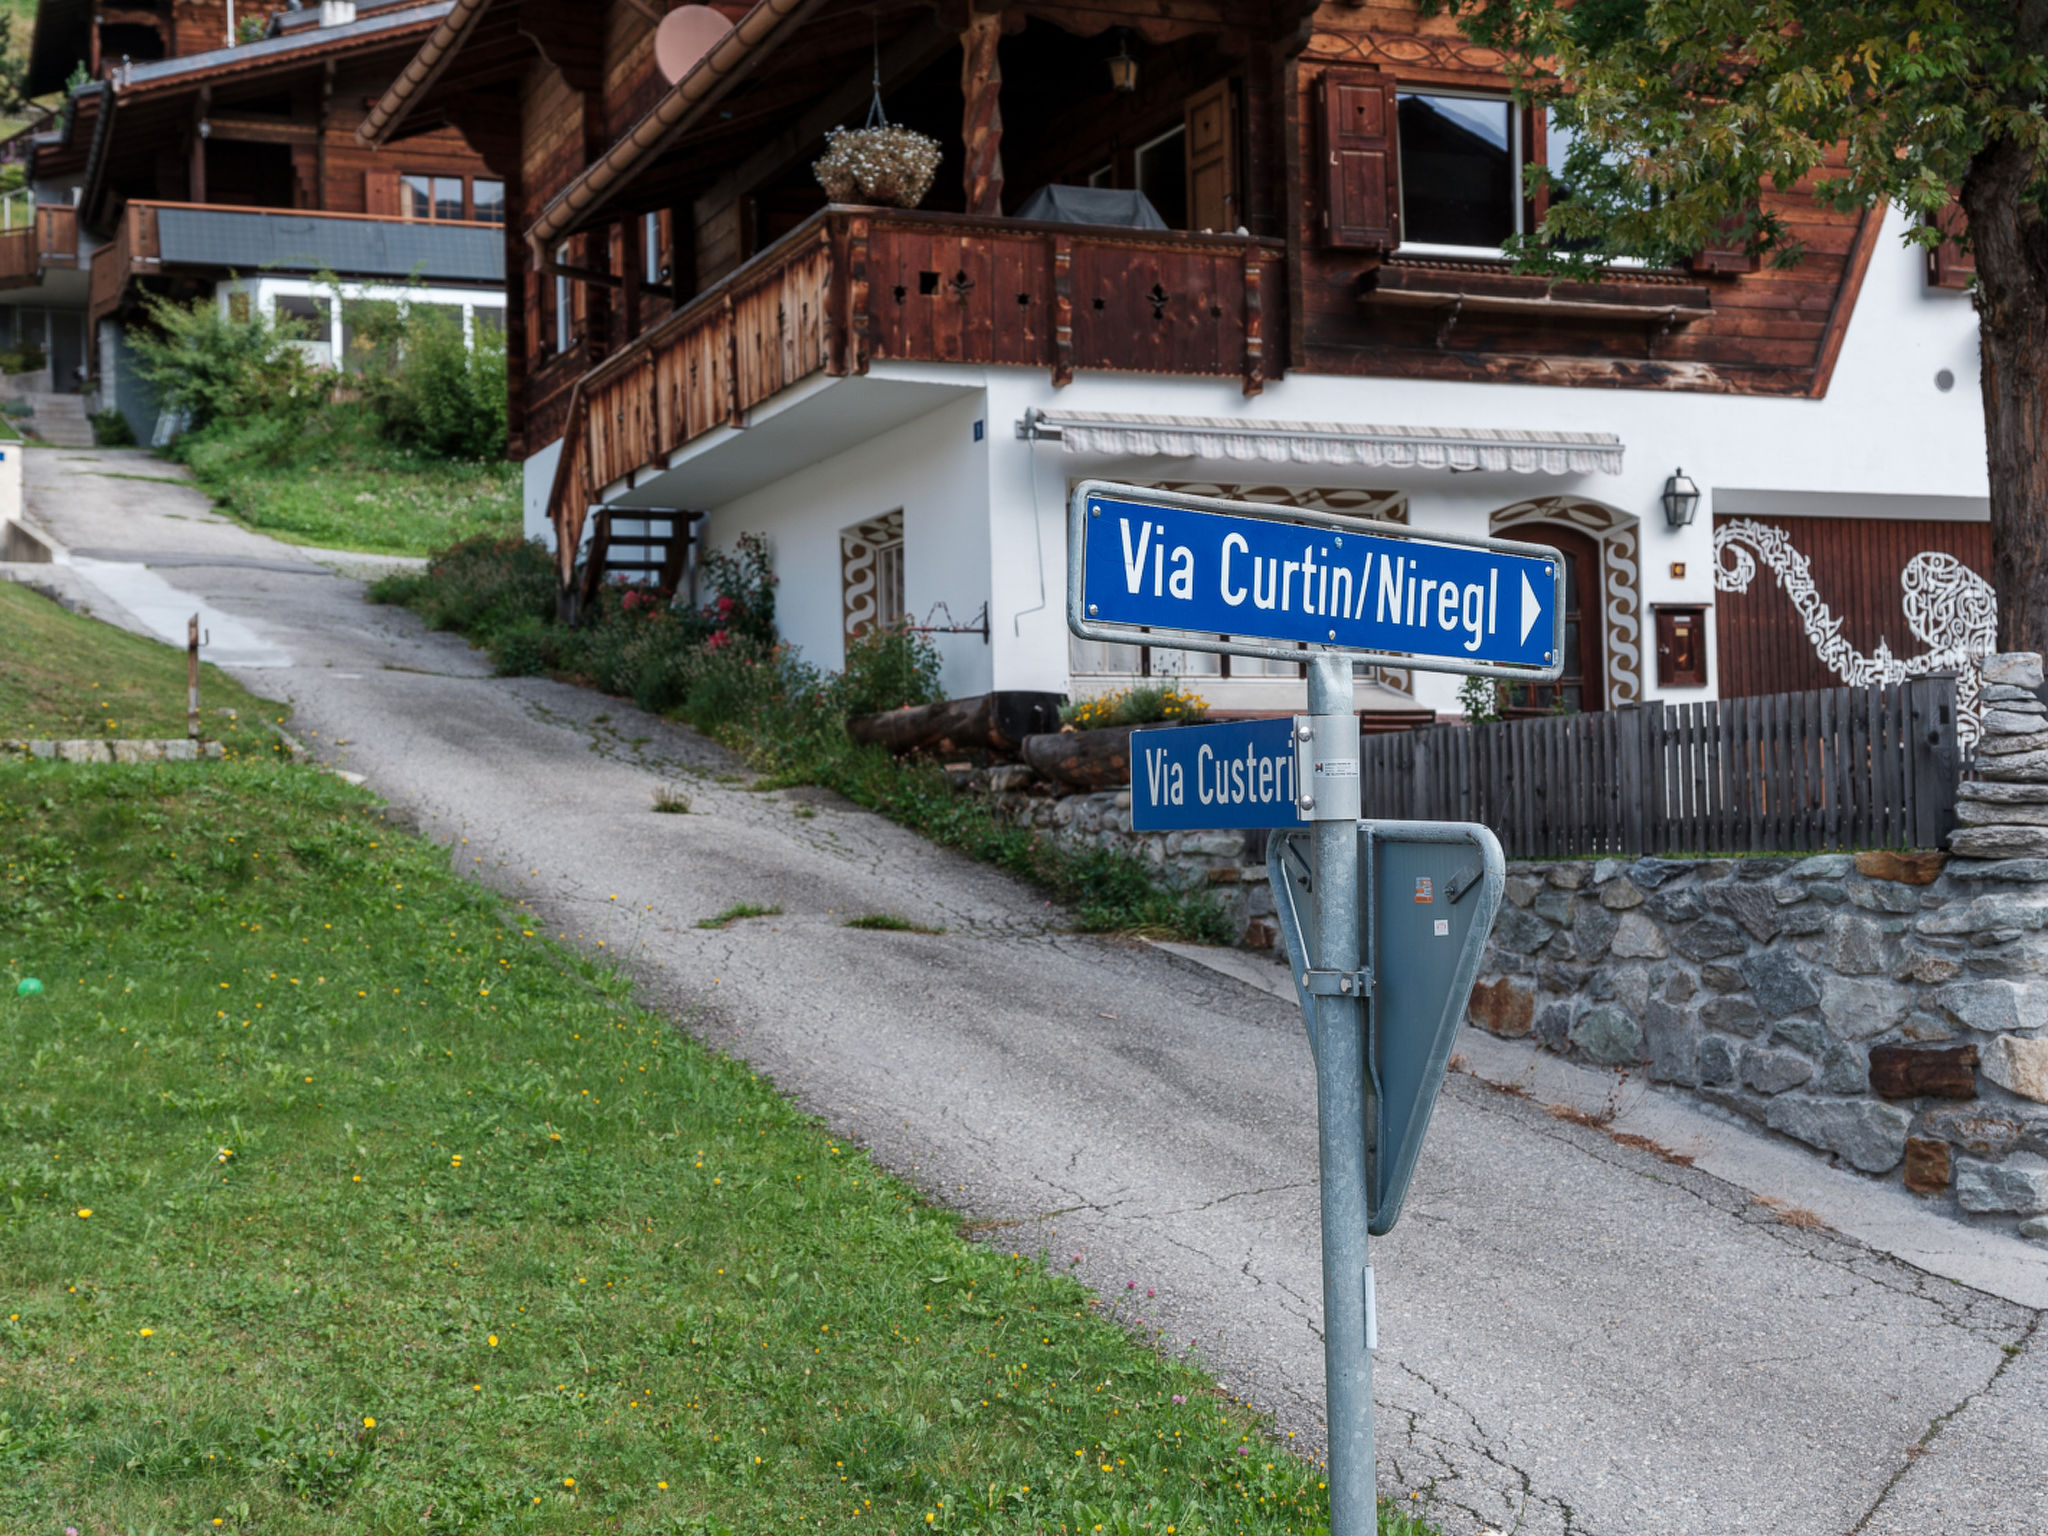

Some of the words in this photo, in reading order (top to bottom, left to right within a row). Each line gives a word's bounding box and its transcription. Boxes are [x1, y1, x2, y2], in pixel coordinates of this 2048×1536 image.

[1119, 518, 1194, 602] Via
[1220, 532, 1498, 652] Curtin/Niregl
[1146, 748, 1184, 807] Via
